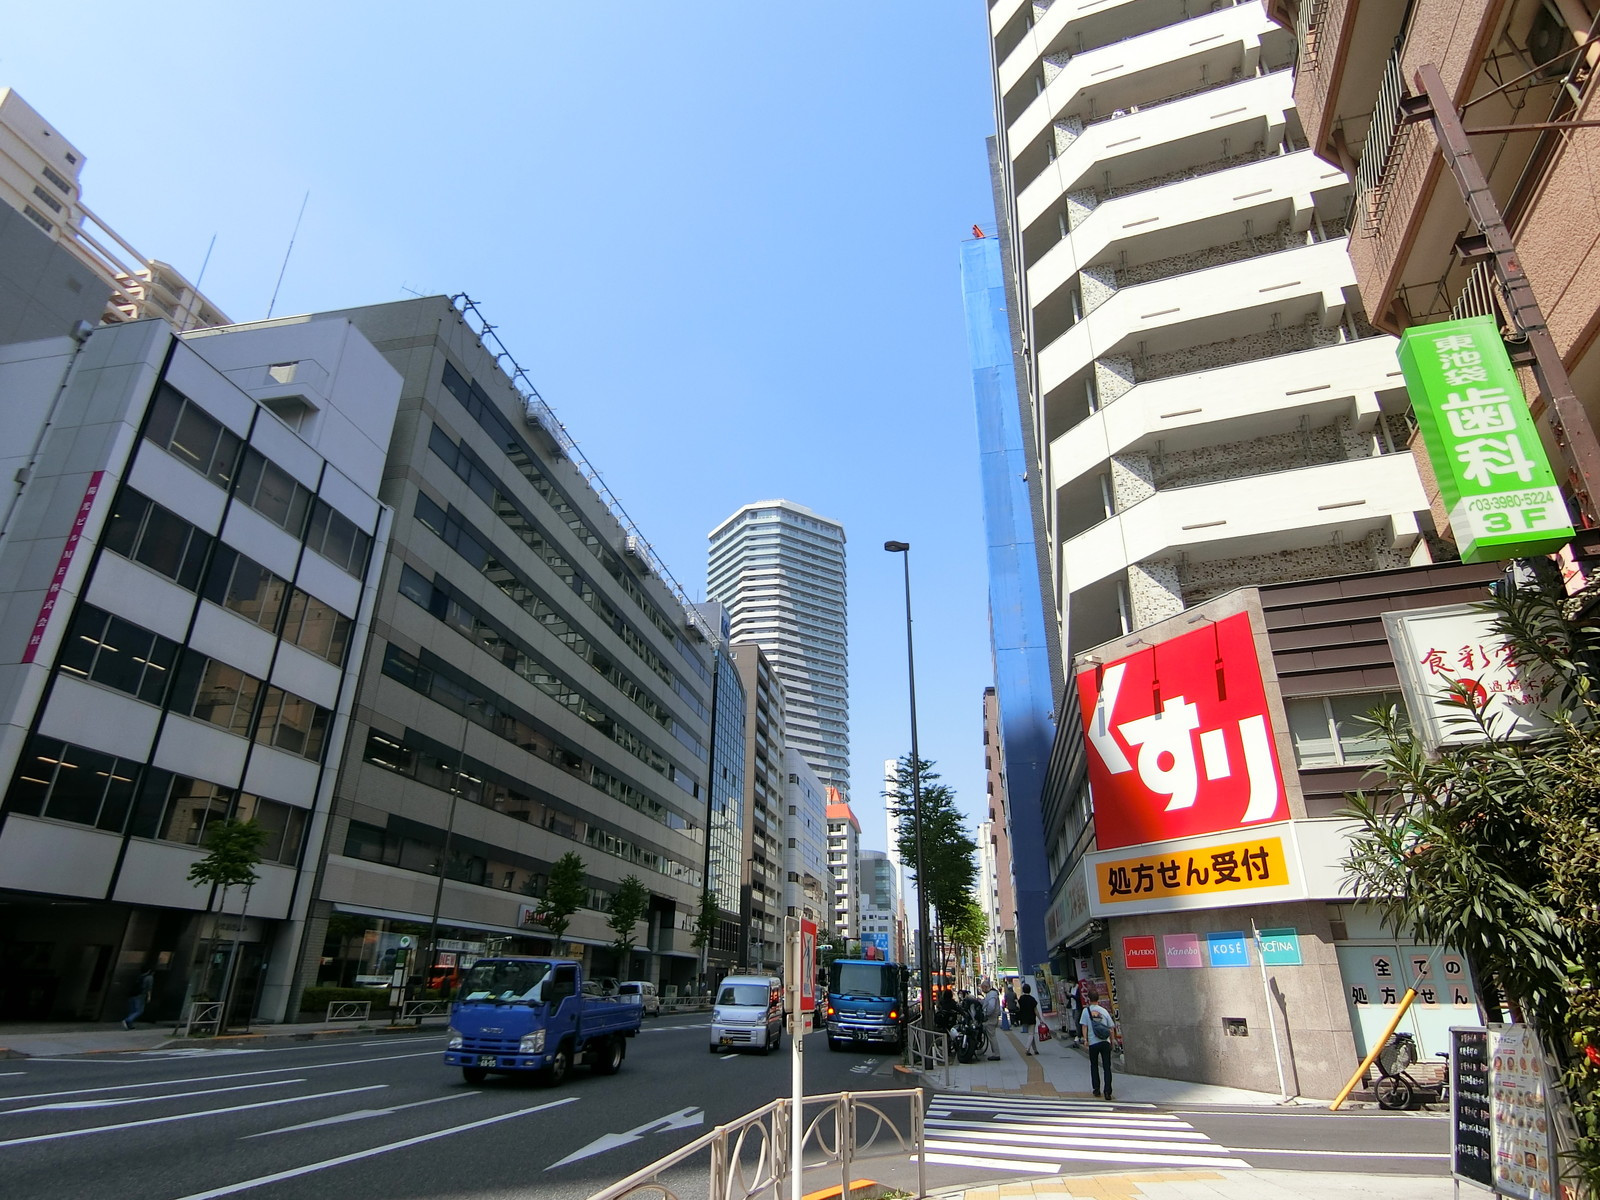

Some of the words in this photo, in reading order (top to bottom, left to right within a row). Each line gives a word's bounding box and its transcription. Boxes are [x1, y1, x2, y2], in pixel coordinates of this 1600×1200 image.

[1432, 333, 1489, 387] 東池袋
[1440, 387, 1536, 487] 歯科
[1474, 490, 1554, 513] 03-3980-5224
[1087, 662, 1279, 823] くすり
[1107, 845, 1270, 896] 処方せん受付
[1127, 948, 1155, 956] SHISEIDO
[1166, 946, 1199, 956] Kanebo
[1212, 942, 1242, 954] KOSÉ
[1374, 958, 1461, 978] 全ての
